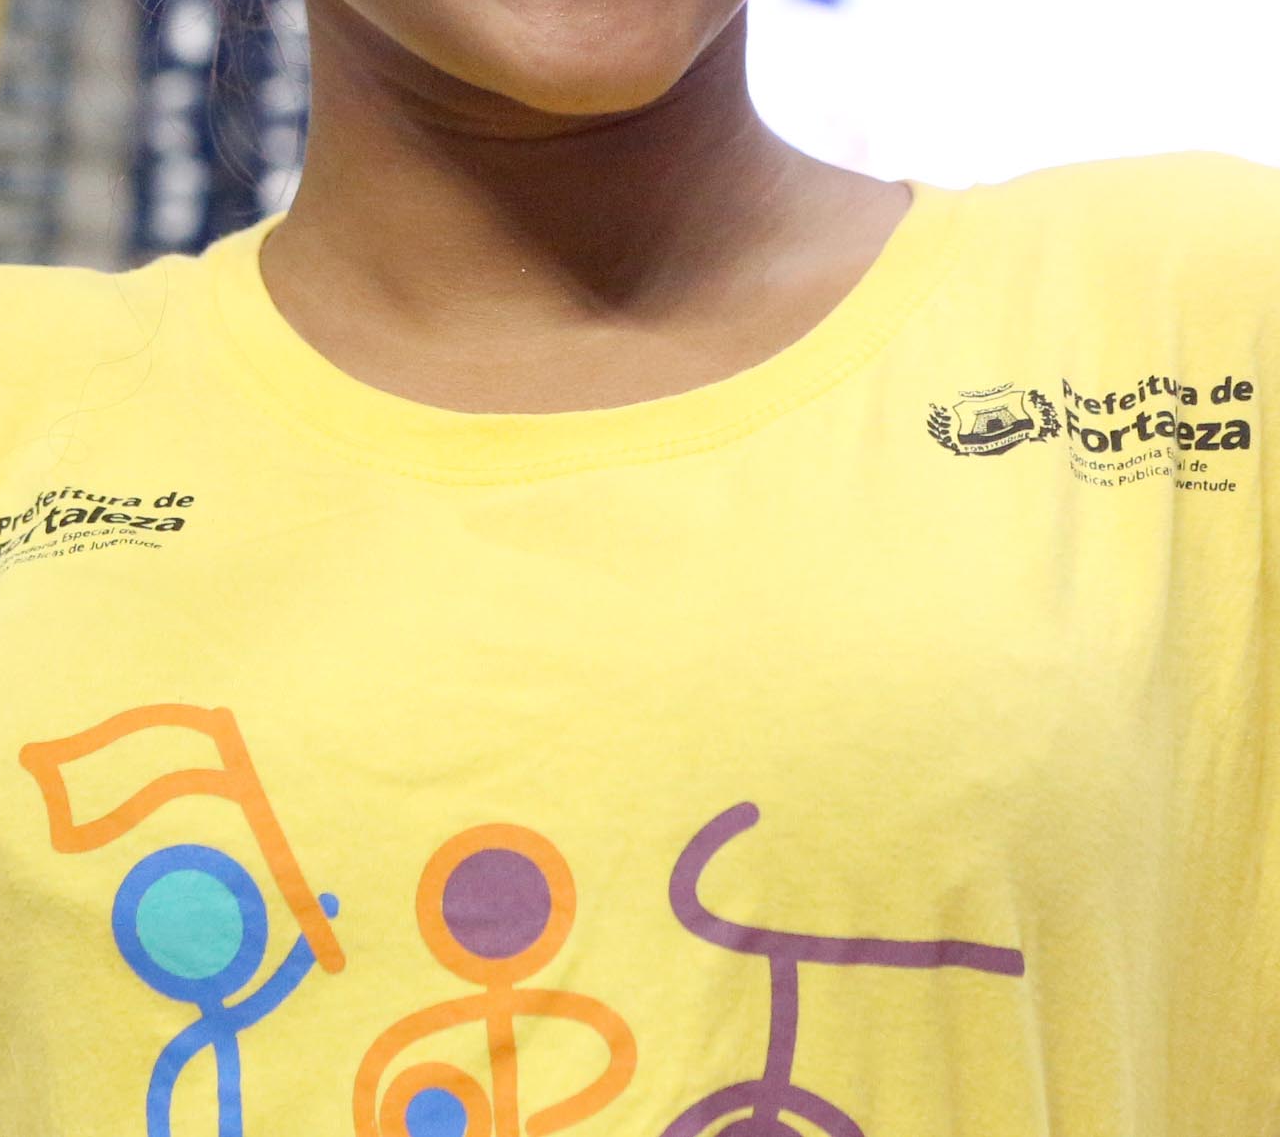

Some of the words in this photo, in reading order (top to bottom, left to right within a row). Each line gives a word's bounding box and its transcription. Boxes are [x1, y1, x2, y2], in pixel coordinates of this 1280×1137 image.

[1062, 375, 1198, 415] Prefeitua
[1211, 376, 1254, 405] de
[1065, 406, 1251, 453] Fortaeza
[1190, 460, 1208, 473] de
[153, 491, 195, 509] de
[68, 543, 85, 555] de
